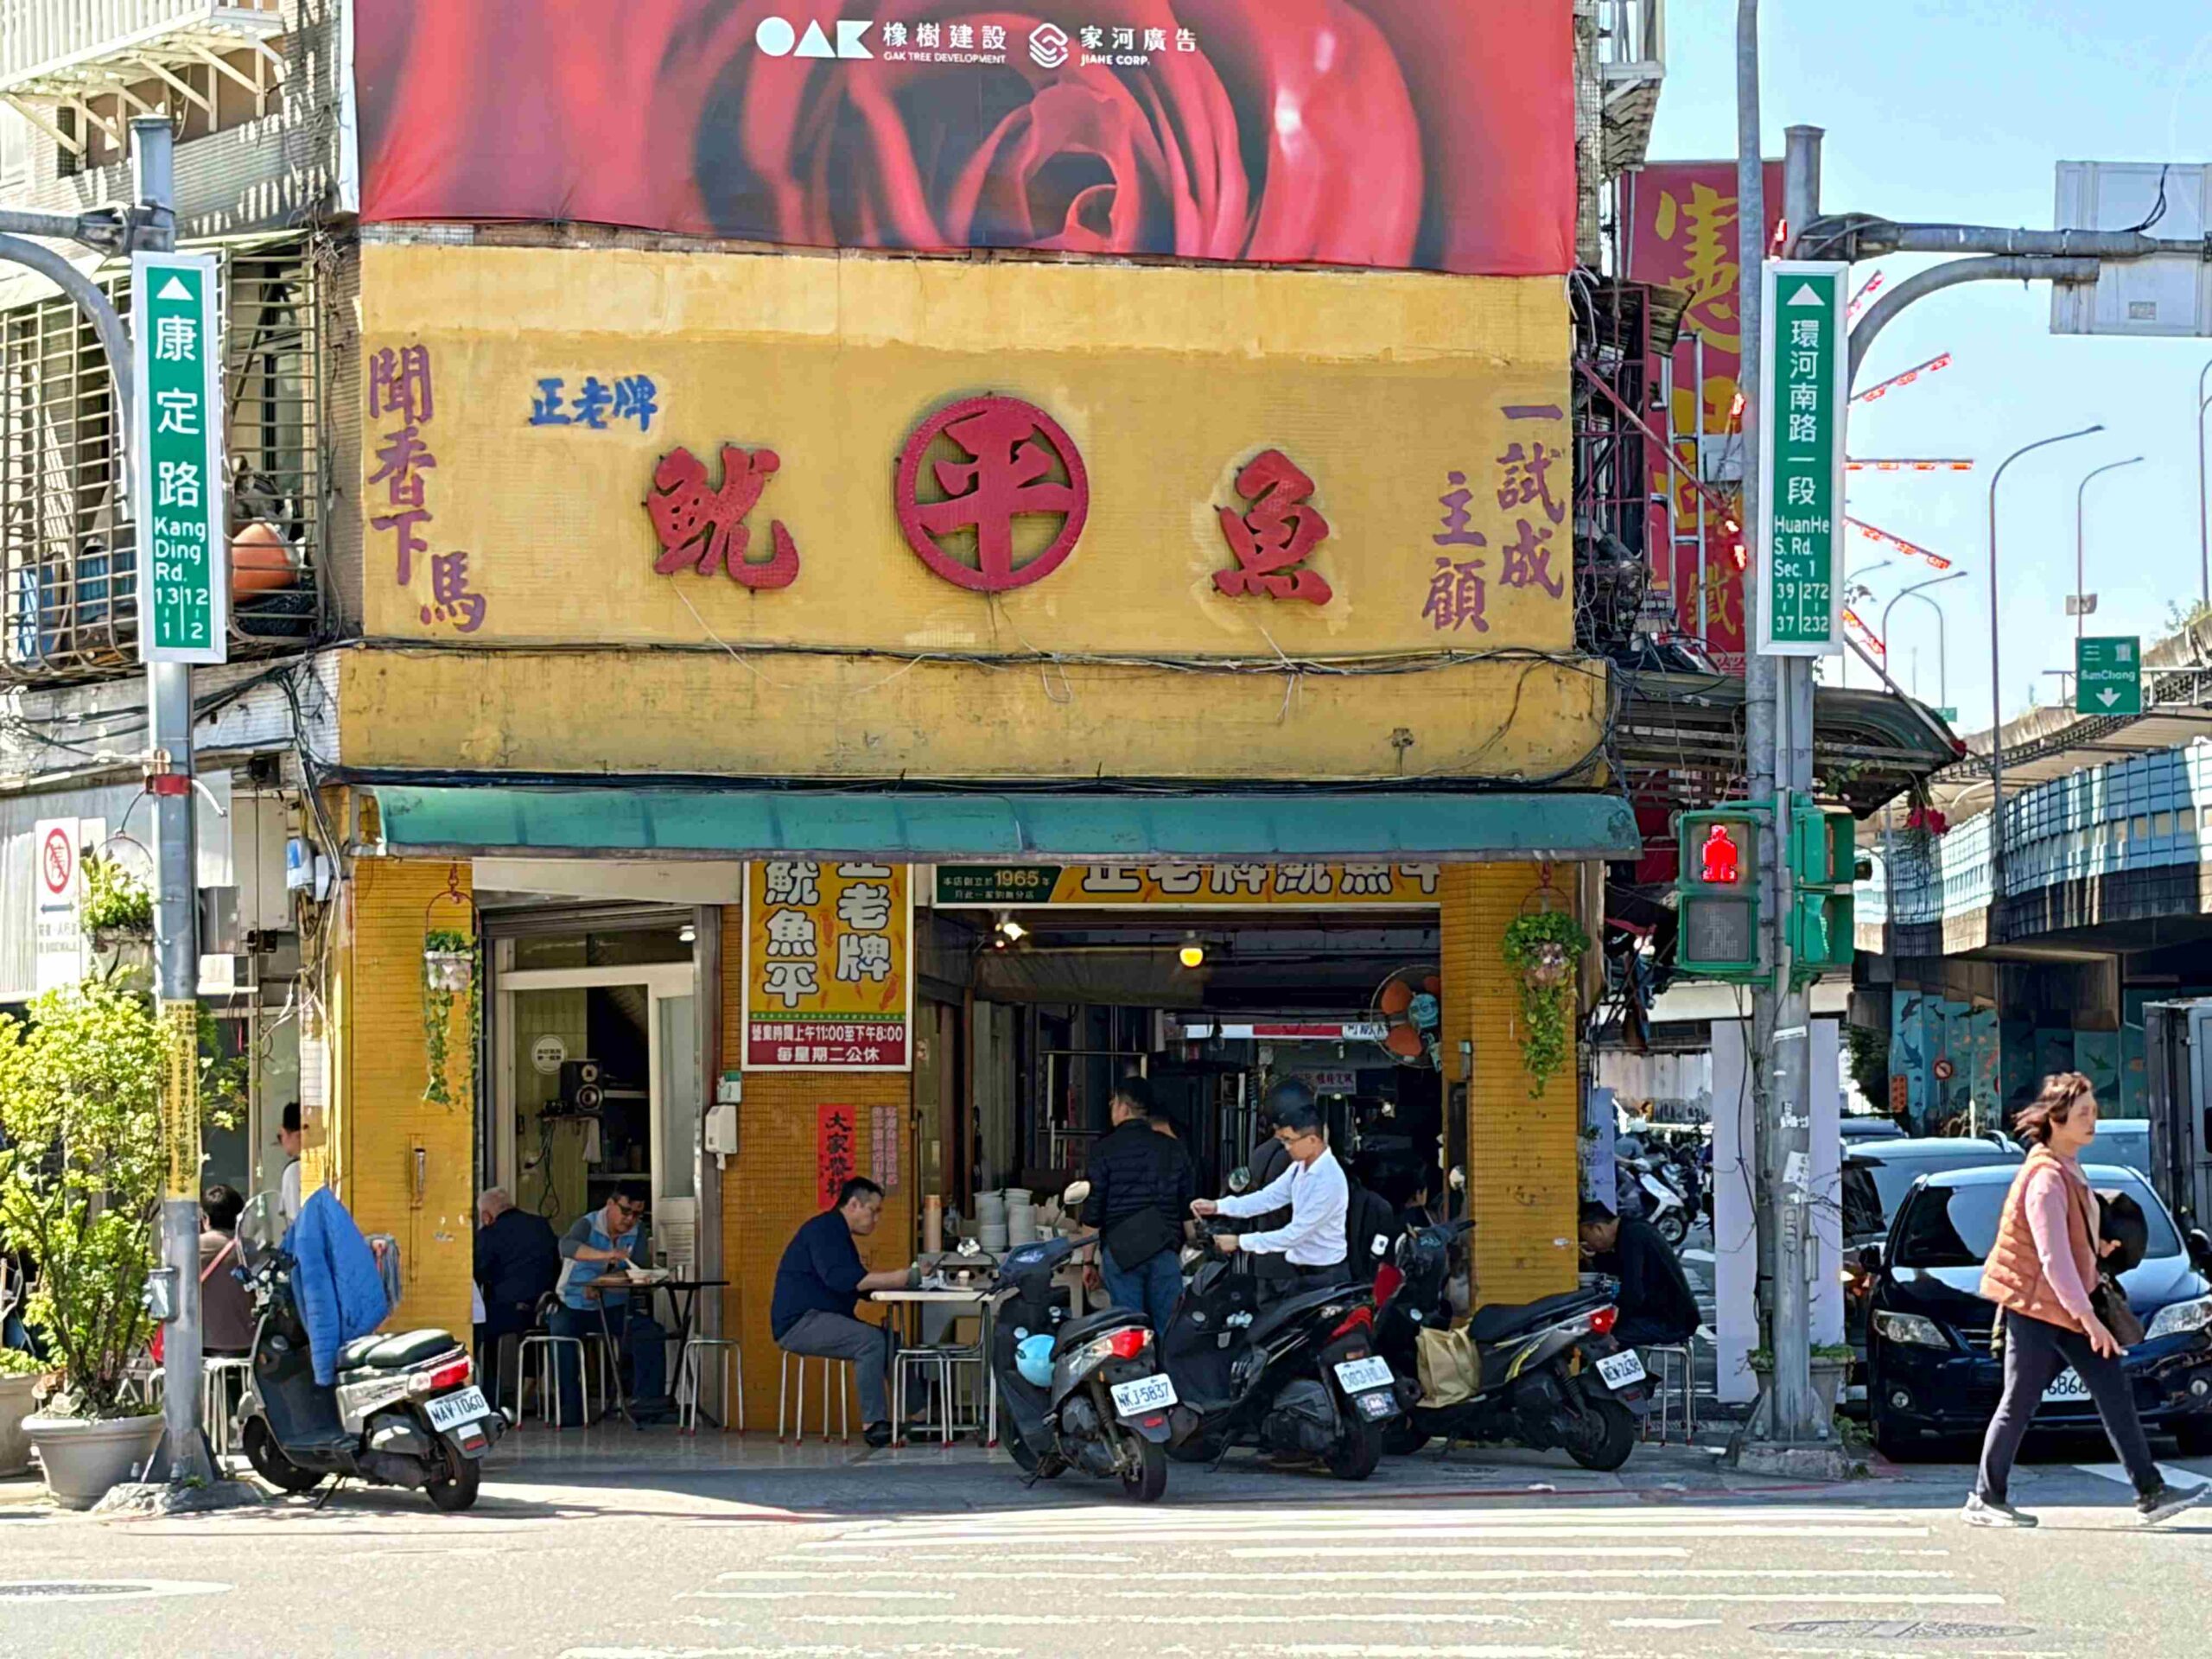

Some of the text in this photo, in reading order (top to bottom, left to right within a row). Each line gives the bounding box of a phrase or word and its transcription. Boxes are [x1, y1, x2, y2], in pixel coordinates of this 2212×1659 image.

[756, 16, 874, 59] OAK
[882, 21, 1007, 49] 橡樹建設
[1080, 25, 1197, 52] 家河廣告
[883, 51, 1006, 64] OAK TREE DEVELOPMENT
[1080, 54, 1113, 66] JIAHE
[155, 315, 200, 507] 康定路
[529, 373, 658, 432] 正老牌
[1787, 320, 1820, 505] 環河南路一段
[368, 344, 486, 632] 聞香下馬
[1497, 403, 1566, 600] 一試成
[154, 517, 206, 543] Kang
[1212, 448, 1334, 607] 魚
[1774, 515, 1830, 534] HuanHe
[155, 539, 200, 565] Ding
[1421, 471, 1490, 633] 主顧
[1774, 537, 1814, 556] S. Rd.
[156, 563, 188, 582] Rd.
[1774, 559, 1815, 578] Sec. 1
[156, 588, 208, 605] 13 12
[1777, 582, 1830, 601] 39 272
[162, 622, 203, 639] 1 2
[1776, 616, 1829, 632] 37 232
[763, 861, 821, 1008] 魷魚平
[777, 1046, 880, 1063] 每星期二公休
